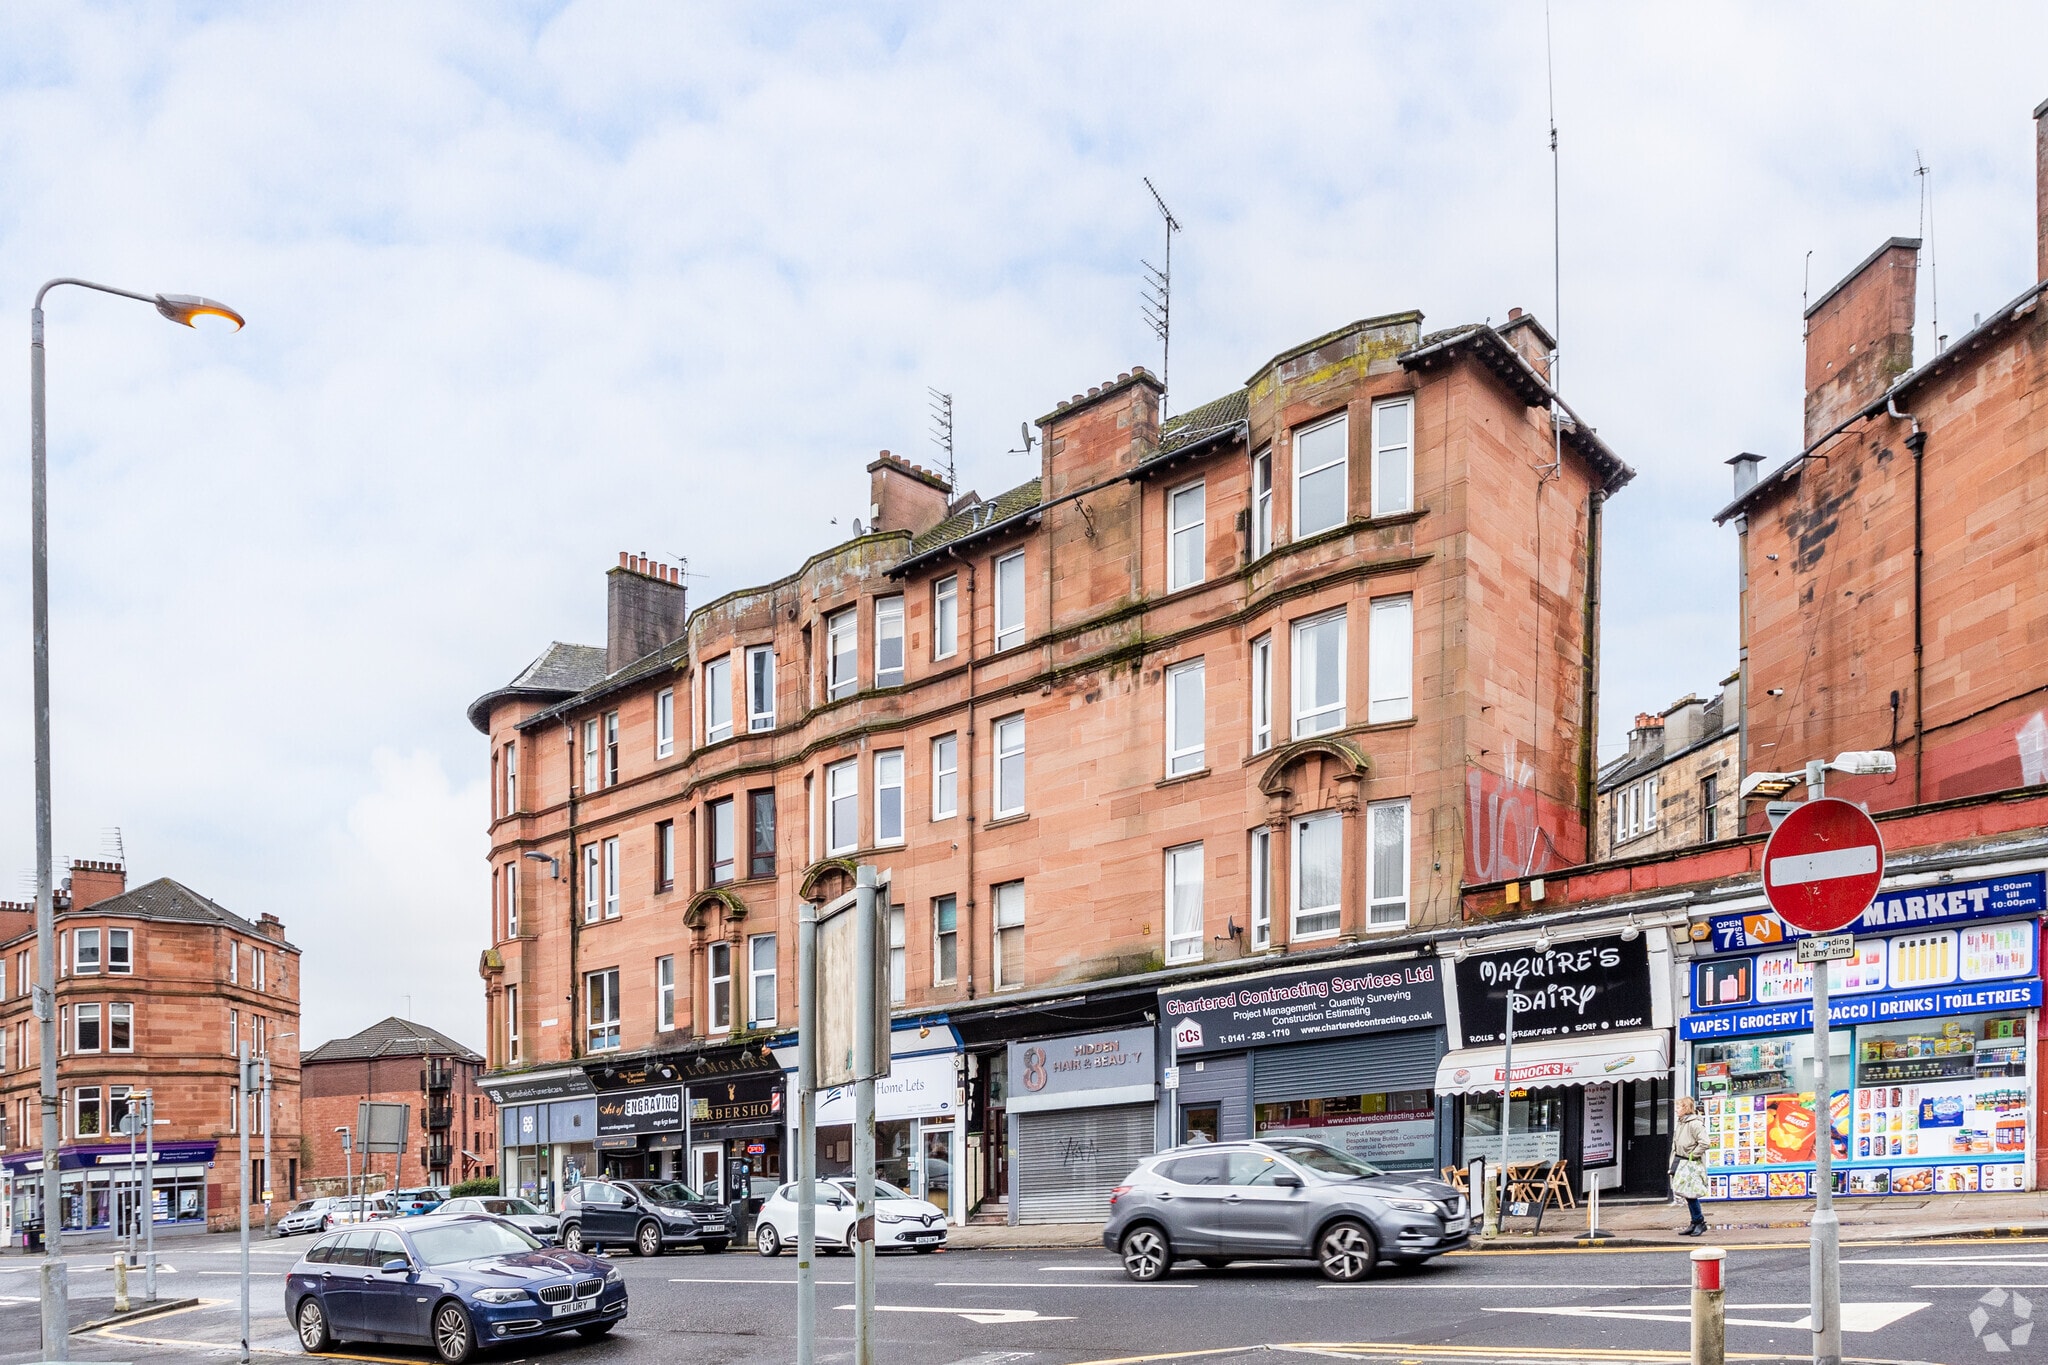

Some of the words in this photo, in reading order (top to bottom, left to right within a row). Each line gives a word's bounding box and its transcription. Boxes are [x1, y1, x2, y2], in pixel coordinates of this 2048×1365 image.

[1993, 881, 2032, 892] 8:00am
[2006, 891, 2019, 899] till
[1863, 887, 1989, 927] MARKET
[1991, 897, 2036, 909] 10:00pm
[1716, 919, 1742, 929] OPEN
[1753, 919, 1770, 939] AJ
[1718, 928, 1735, 948] 7
[1736, 927, 1744, 947] DAYS
[1802, 941, 1814, 949] No
[1813, 949, 1828, 957] any
[1832, 947, 1851, 955] time
[1479, 947, 1621, 990] MAGUIRE'S
[1166, 991, 1236, 1015] Chartered
[1239, 981, 1329, 1006] Contracting
[1332, 972, 1402, 993] Services
[1405, 965, 1434, 985] Ltd
[1233, 1009, 1261, 1021] Project
[1263, 1001, 1316, 1017] Management
[1329, 996, 1365, 1008] Quantity
[1367, 991, 1411, 1004] Surveying
[1506, 984, 1597, 1015] DAIRY
[1272, 1012, 1324, 1026] Construction
[1325, 1006, 1371, 1020] Estimating
[1690, 1018, 1730, 1034] VAPES
[1739, 1011, 1799, 1029] GROCERY
[1807, 1004, 1868, 1022] TBACCO
[1880, 997, 1934, 1015] DRINKS
[1943, 987, 2031, 1009] TOILETRIES
[1228, 1033, 1245, 1043] 0141
[1251, 1031, 1266, 1040] 258
[1271, 1028, 1290, 1038] 1710
[1300, 1011, 1433, 1034] www.charteredcontracting.co.uk
[1073, 1040, 1120, 1057] HIDDEN
[1023, 1046, 1048, 1092] 8
[1053, 1059, 1081, 1073] HAIR
[1497, 1063, 1561, 1080] TNNOCK'S
[532, 1086, 563, 1096] Funeralcare
[876, 1081, 903, 1095] Home
[906, 1078, 925, 1092] Lets
[1510, 1090, 1527, 1098] OPEN
[625, 1093, 679, 1117] ENGRAVING
[691, 1103, 769, 1122] RBERSHO
[1365, 1128, 1399, 1136] Management
[747, 1145, 763, 1153] OPEN
[573, 1300, 588, 1311] URY
